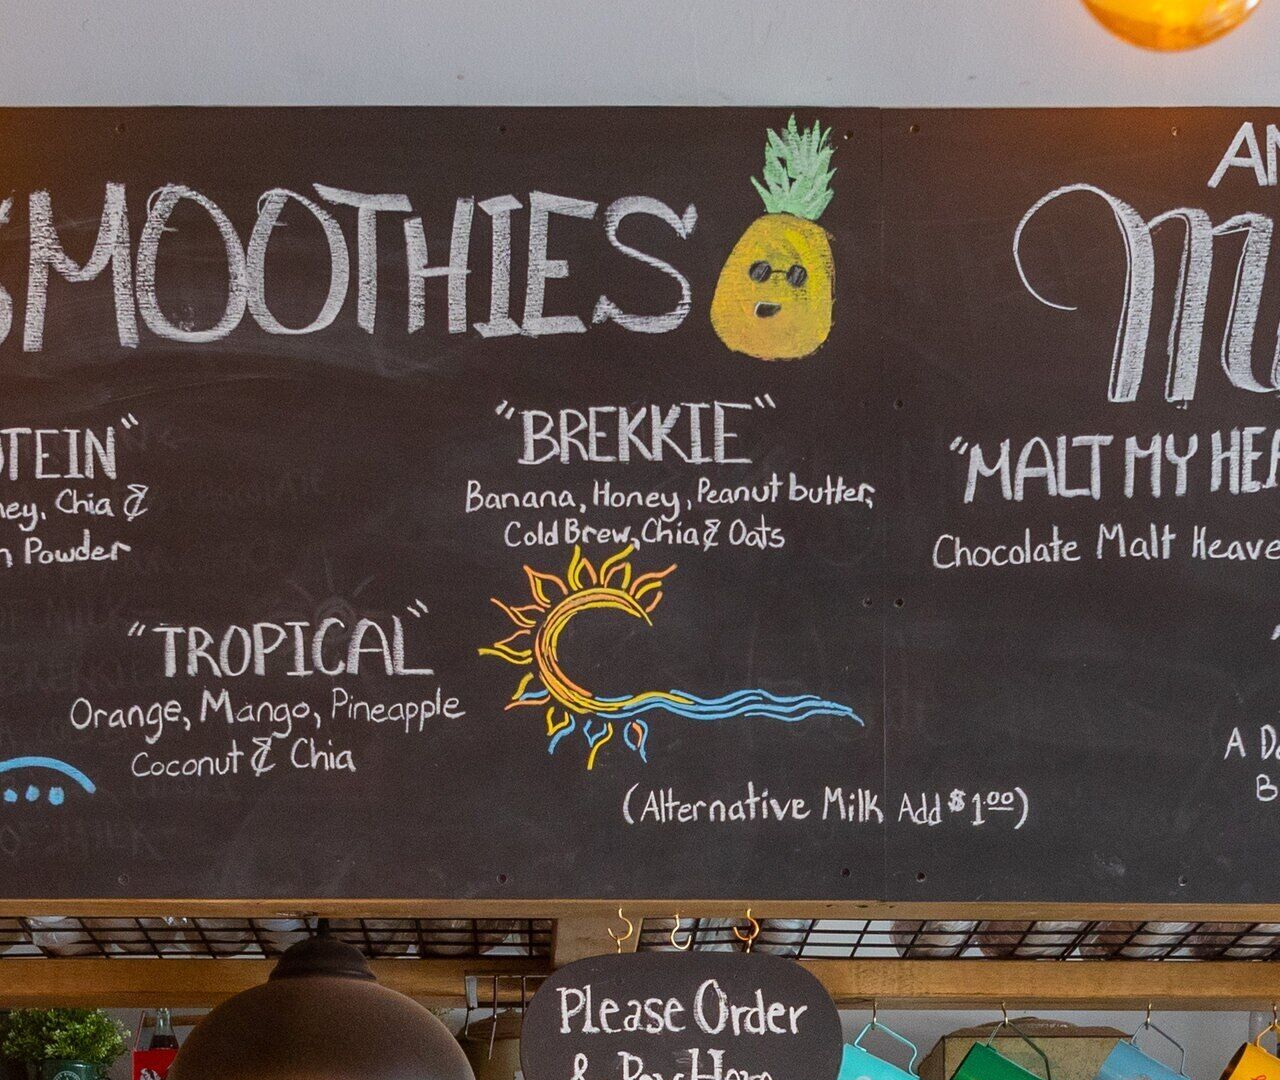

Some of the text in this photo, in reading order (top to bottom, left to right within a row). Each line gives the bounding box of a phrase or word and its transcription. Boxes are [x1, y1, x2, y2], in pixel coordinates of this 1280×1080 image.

[1124, 433, 1198, 498] MY
[623, 781, 810, 824] (Alternative
[822, 787, 883, 823] Milk
[898, 793, 942, 826] Add
[556, 979, 807, 1036] Please Order
